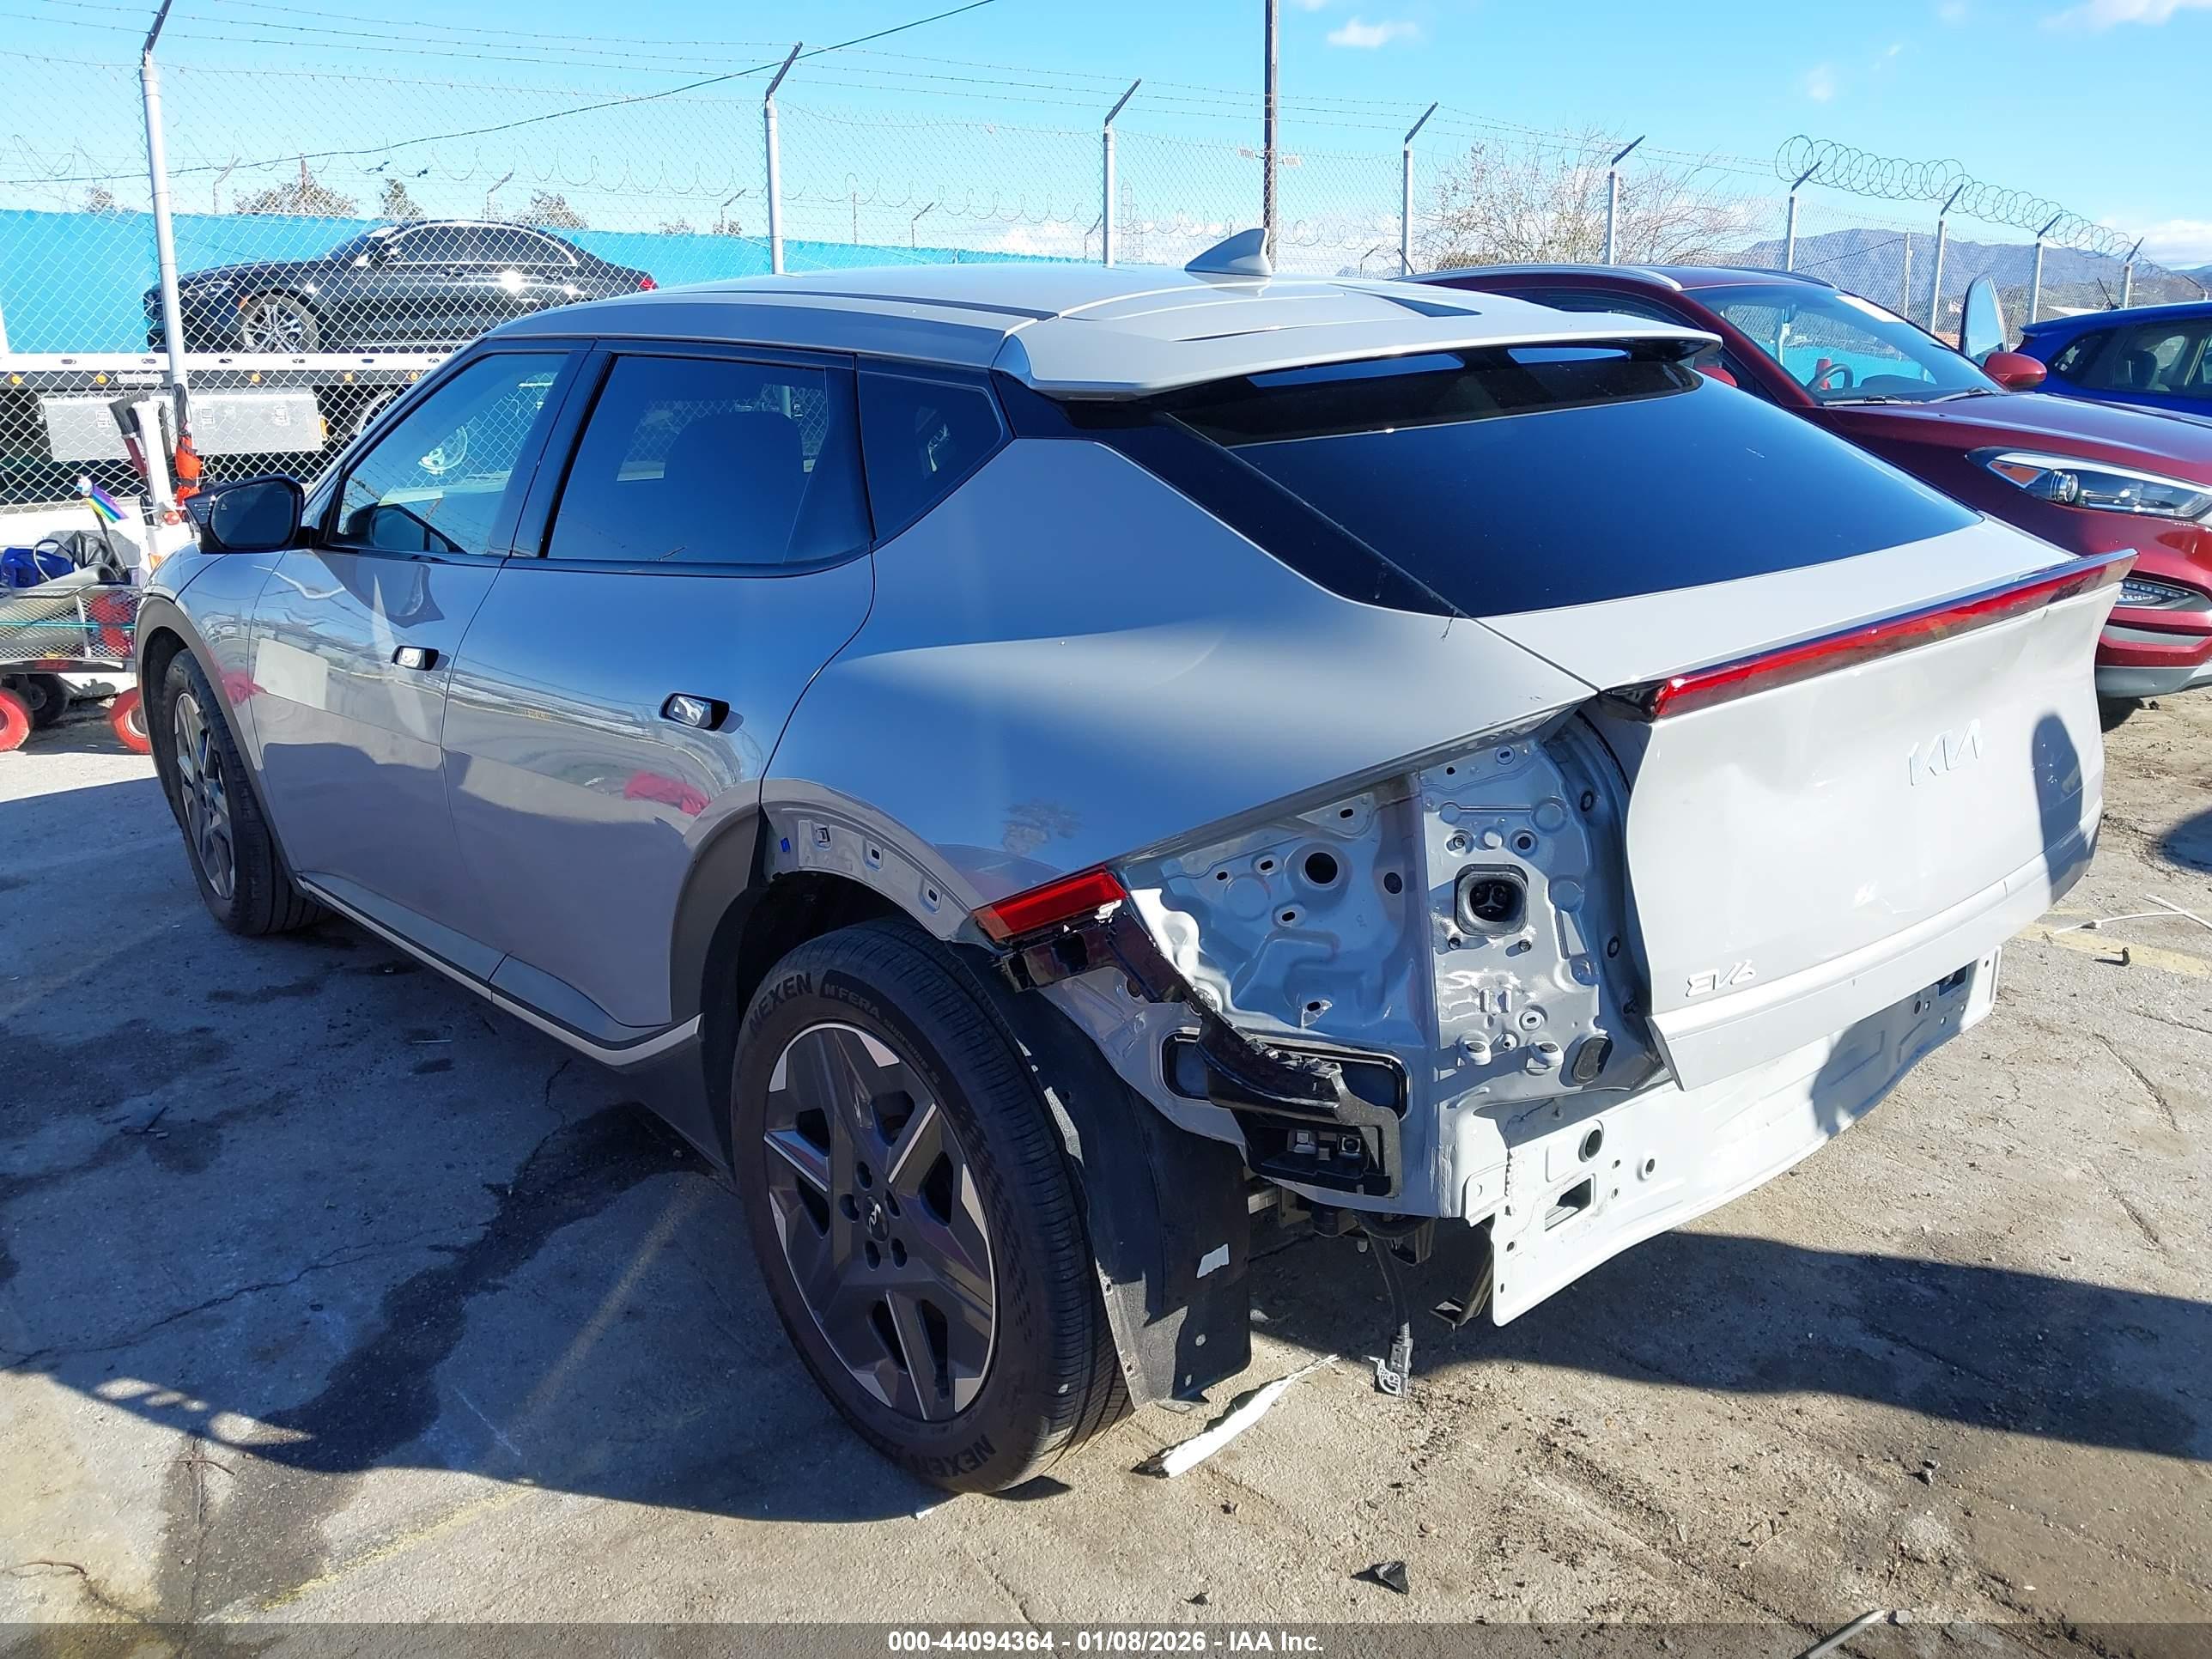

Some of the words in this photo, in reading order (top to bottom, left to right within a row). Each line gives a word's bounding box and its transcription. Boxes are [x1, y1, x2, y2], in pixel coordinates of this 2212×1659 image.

[1907, 718, 1982, 787] KIA
[748, 972, 813, 1033] NEXEN
[824, 982, 880, 1019] N'FERA
[1685, 959, 1757, 998] EV6
[909, 1433, 997, 1477] NEXEN
